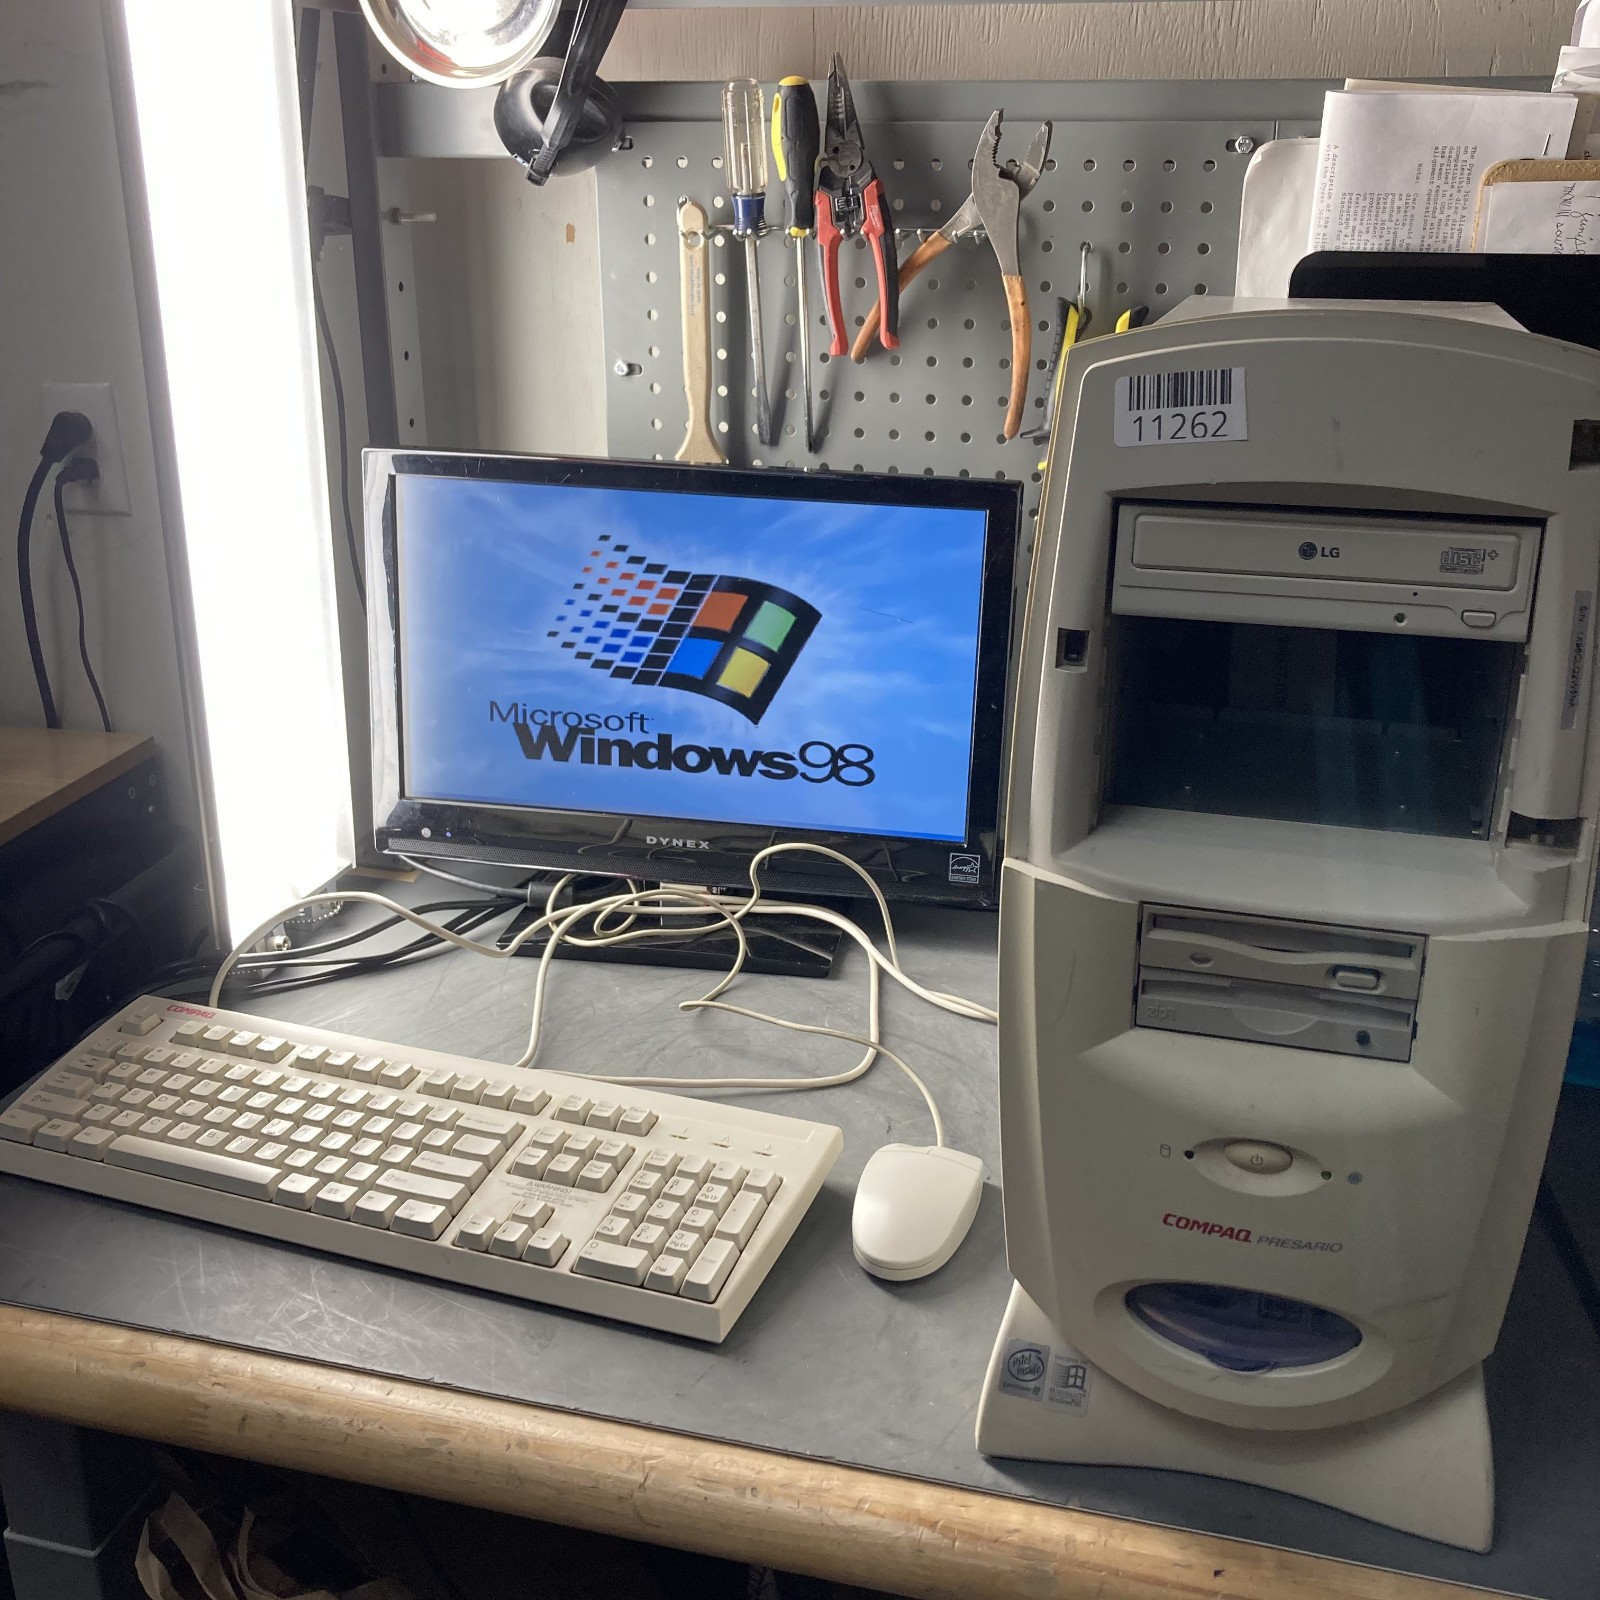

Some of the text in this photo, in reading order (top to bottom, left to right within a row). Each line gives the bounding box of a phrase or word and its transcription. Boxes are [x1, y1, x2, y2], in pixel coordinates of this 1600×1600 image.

[1463, 146, 1468, 155] on
[1327, 153, 1338, 200] description
[1414, 163, 1423, 184] Note:
[1429, 146, 1440, 185] alignment
[1444, 146, 1455, 185] described
[1450, 146, 1461, 189] compatible
[1457, 160, 1467, 193] flexible
[1465, 163, 1474, 185] Dysan
[1326, 203, 1331, 212] of
[1353, 193, 1361, 222] feature
[1362, 193, 1367, 201] on
[1381, 193, 1390, 214] Dysan
[1388, 193, 1396, 222] punched
[1398, 193, 1403, 201] as
[1431, 185, 1440, 218] recorded
[1442, 190, 1448, 198] in
[1338, 192, 1347, 226] Standard
[1343, 192, 1354, 230] paragraph
[1365, 193, 1375, 235] protective
[1372, 193, 1382, 239] inadvertent
[1396, 206, 1402, 214] an
[1401, 193, 1411, 230] diskette.
[1422, 189, 1433, 231] operations
[1406, 214, 1415, 240] should
[1434, 218, 1442, 243] manual
[1455, 215, 1466, 252] Alignment
[1133, 410, 1228, 442] 11262
[1320, 546, 1340, 559] LG
[488, 700, 648, 734] Microsoft
[514, 722, 876, 787] Windows 98
[646, 836, 710, 850] DYNEX
[166, 1004, 216, 1019] COMPAQ
[1162, 1212, 1344, 1253] COMPAQ PRESARIO
[1012, 1353, 1032, 1366] intel
[1016, 1365, 1041, 1376] inside
